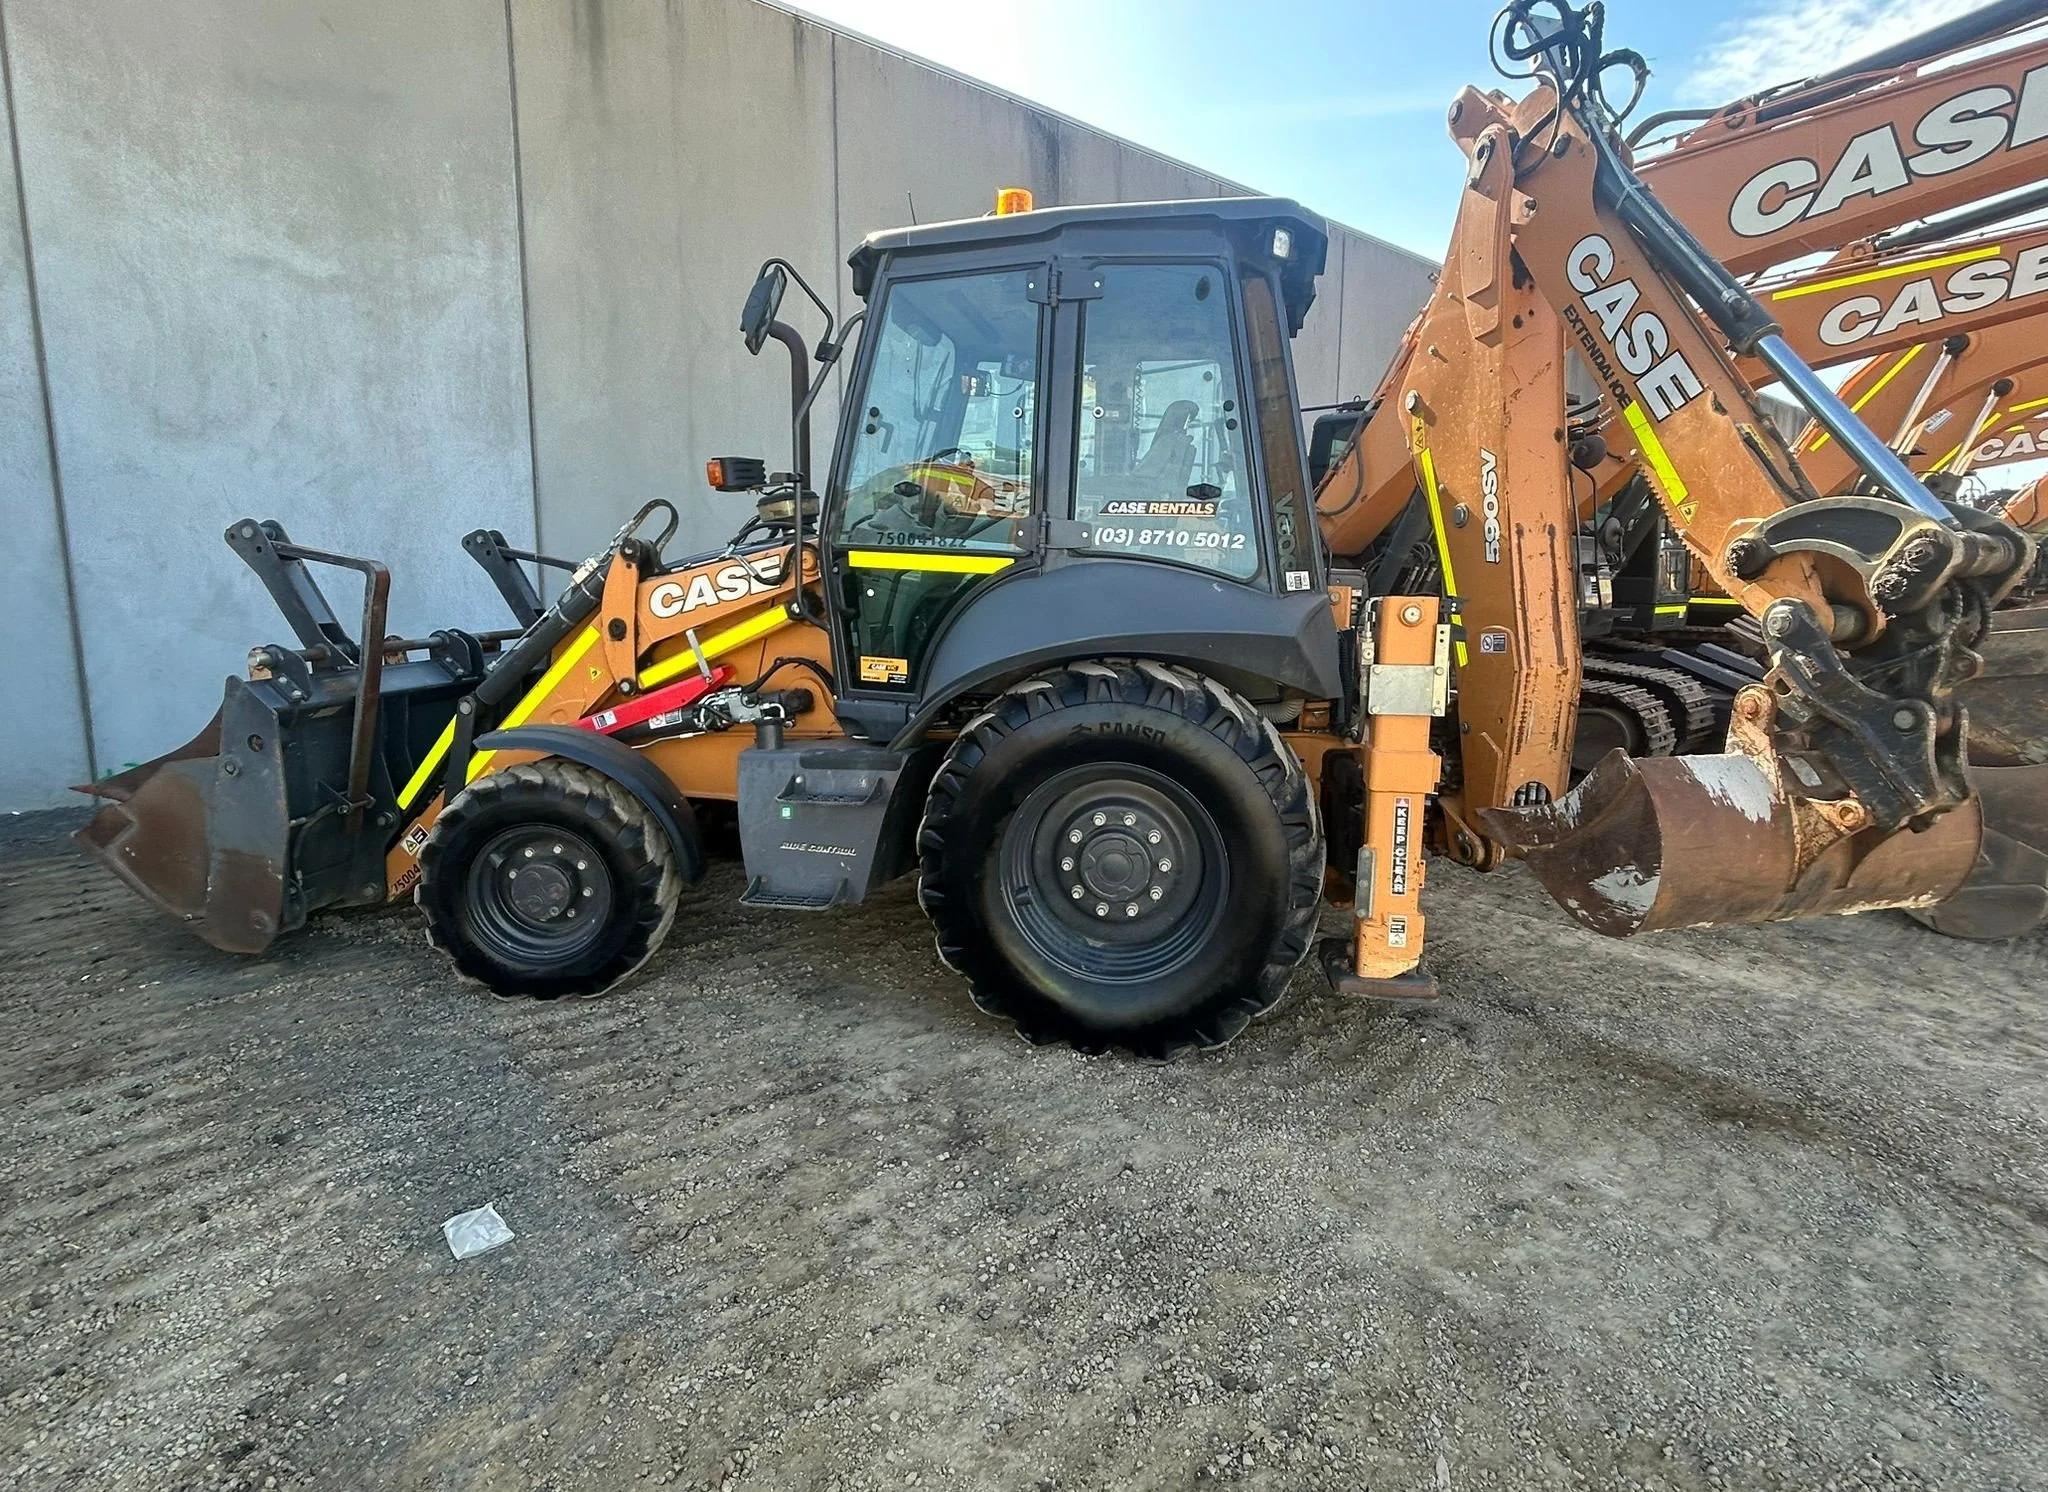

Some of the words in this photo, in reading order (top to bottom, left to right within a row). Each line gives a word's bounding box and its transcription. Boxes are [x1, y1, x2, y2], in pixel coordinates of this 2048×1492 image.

[1566, 233, 1704, 423] CASE
[1107, 502, 1147, 514] CASE
[1148, 503, 1214, 515] RENTALS
[1480, 447, 1500, 564] 590SV
[1094, 527, 1134, 547] (03)
[1138, 529, 1189, 546] 8710
[1193, 532, 1246, 549] 5012
[649, 554, 781, 619] CASE
[1396, 807, 1409, 844] KEEP
[1393, 846, 1408, 894] CLEAR
